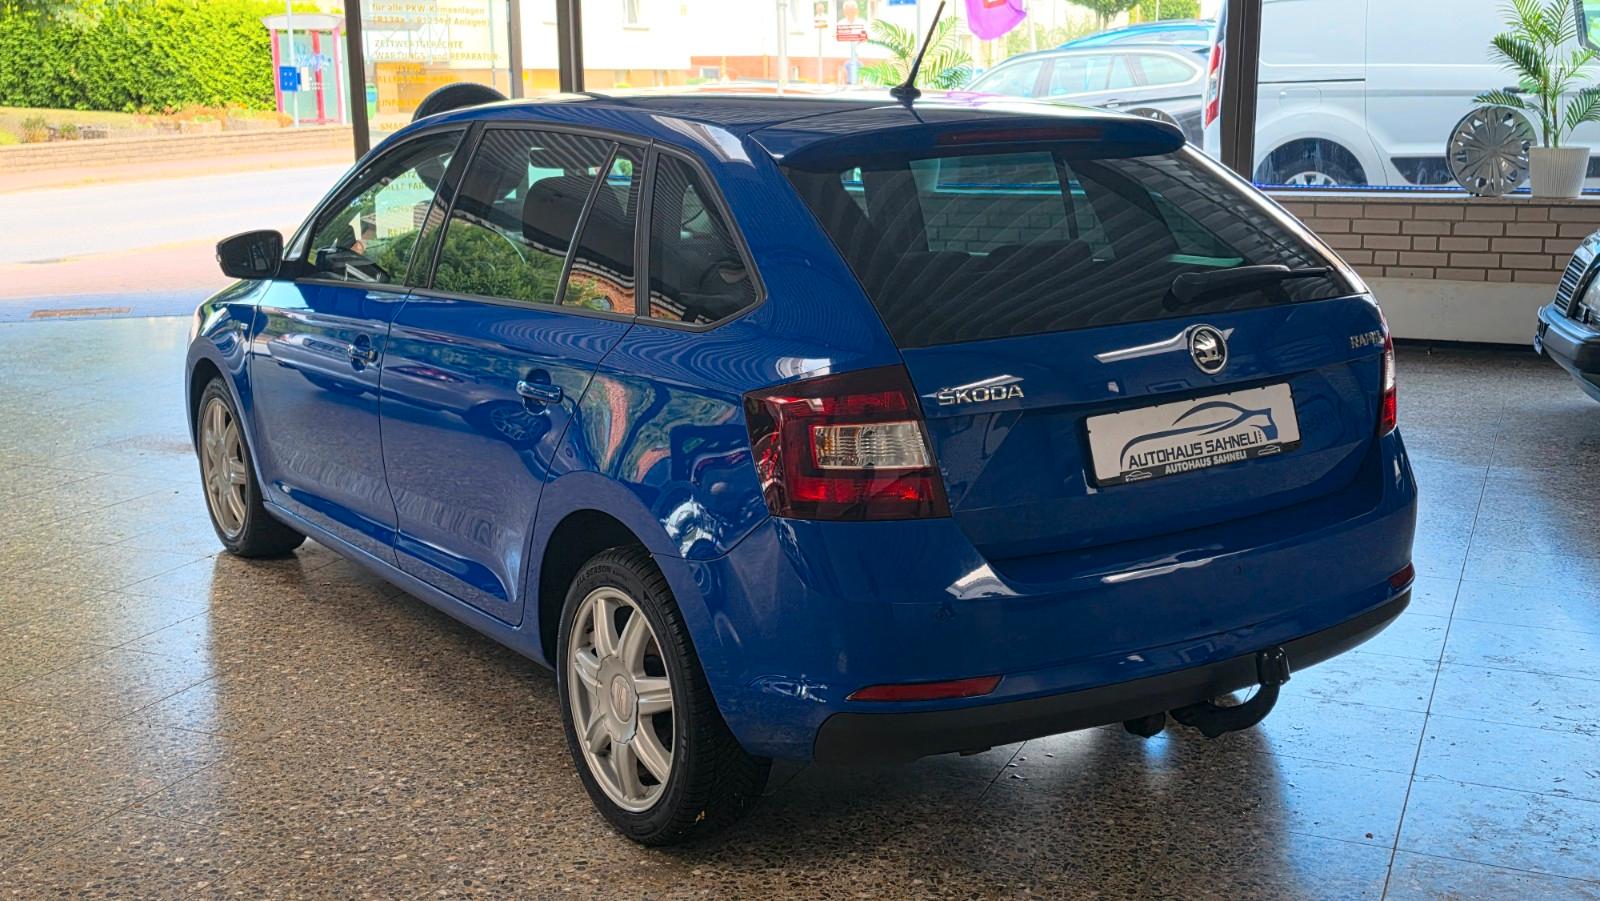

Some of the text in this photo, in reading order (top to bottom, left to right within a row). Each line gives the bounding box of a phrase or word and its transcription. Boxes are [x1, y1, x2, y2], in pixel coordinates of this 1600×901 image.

[405, 3, 425, 13] PKW
[938, 384, 1025, 406] ŠKODA
[1128, 442, 1204, 469] AUTOHAUS
[1205, 431, 1258, 455] SAHNELI
[1164, 449, 1247, 475] AUTOHAUS SAHNELI
